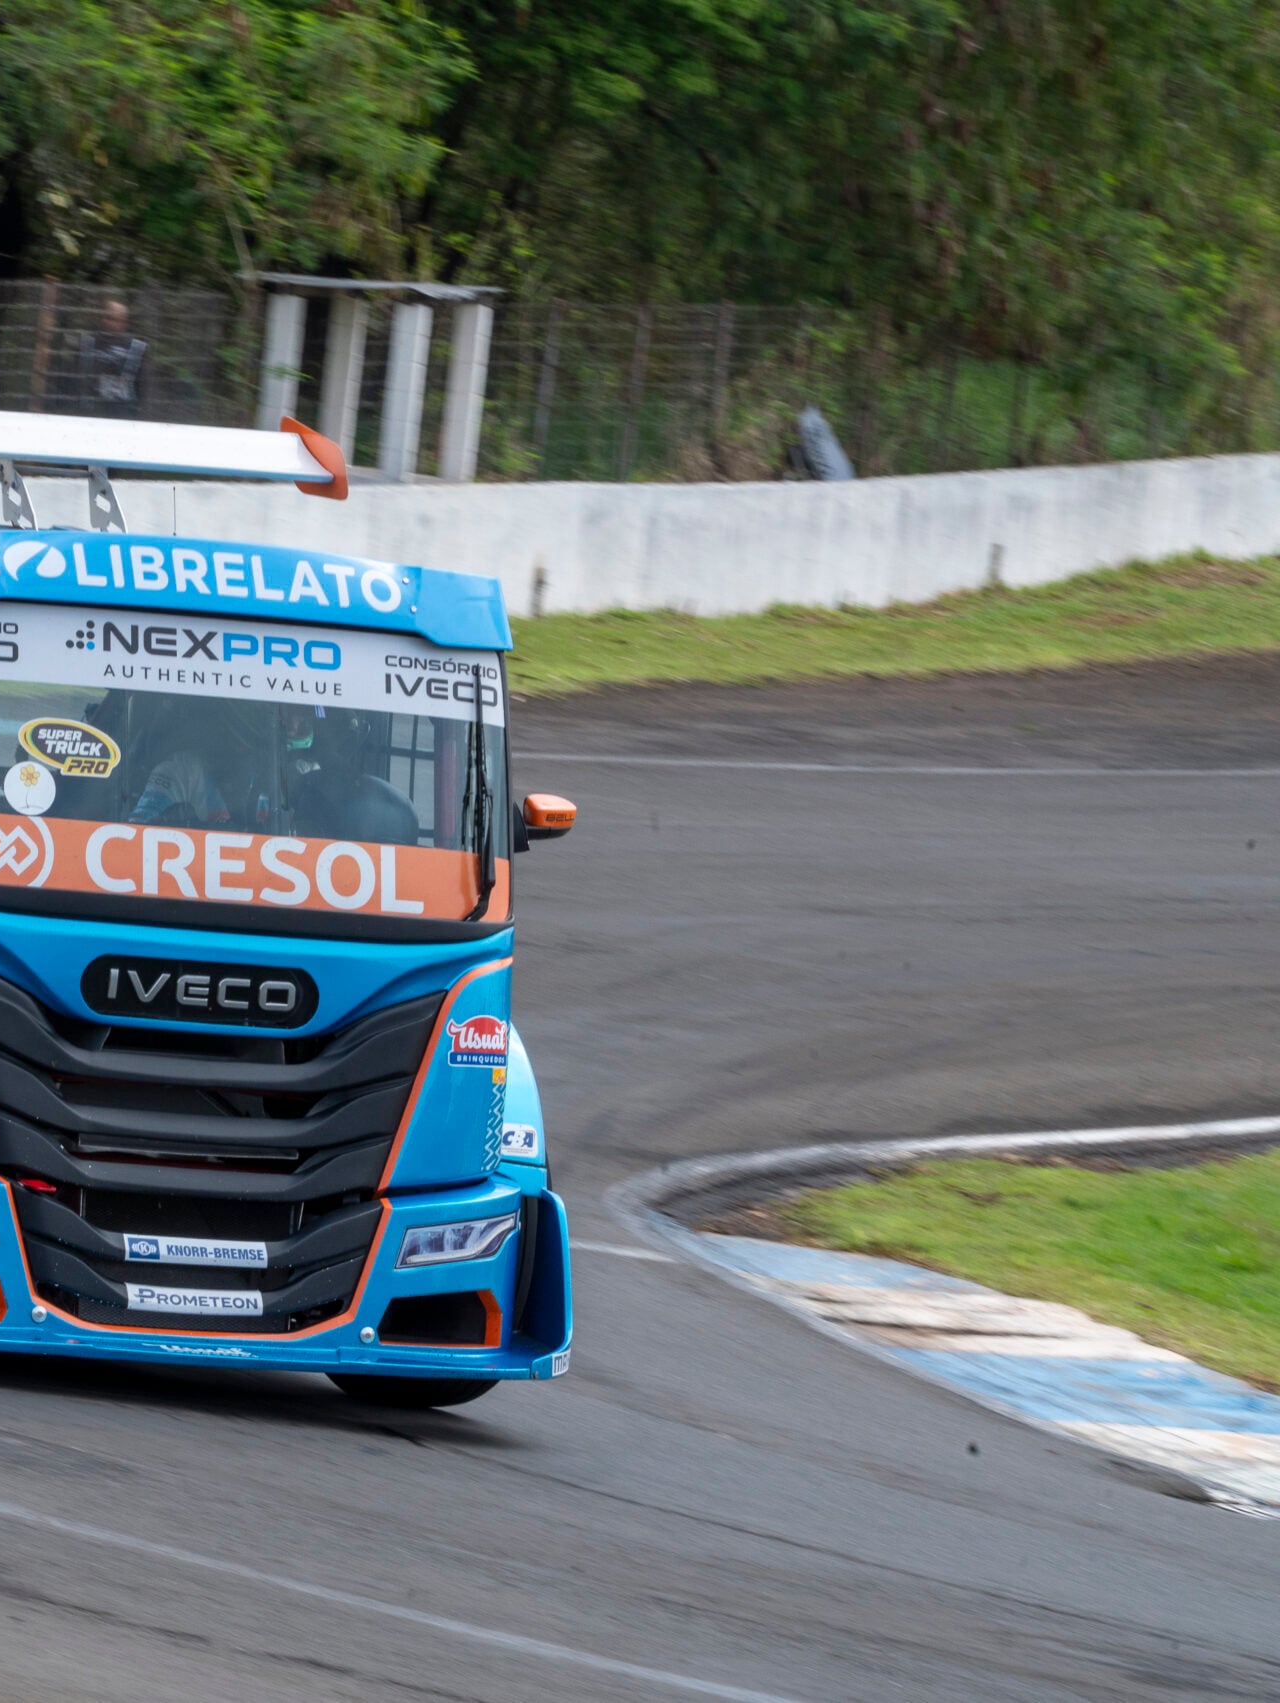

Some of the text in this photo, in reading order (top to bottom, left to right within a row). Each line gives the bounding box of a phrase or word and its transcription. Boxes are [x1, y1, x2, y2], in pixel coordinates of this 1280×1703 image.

[72, 542, 402, 613] LIBRELATO
[103, 621, 341, 671] NEXPRO
[104, 664, 342, 696] AUTHENTIC VALUE
[385, 654, 498, 680] CONSÓRCIO
[385, 673, 498, 708] IVECO
[38, 728, 83, 741] SUPER
[45, 740, 103, 757] TRUCK
[67, 759, 109, 774] PRO
[85, 824, 425, 914] CRESOL
[107, 967, 297, 1012] IVECO
[450, 1023, 507, 1051] Usual
[456, 1054, 505, 1064] BRINQUEDOS
[166, 1244, 265, 1261] KNORR-BREMSE
[134, 1288, 258, 1310] PROMETEON
